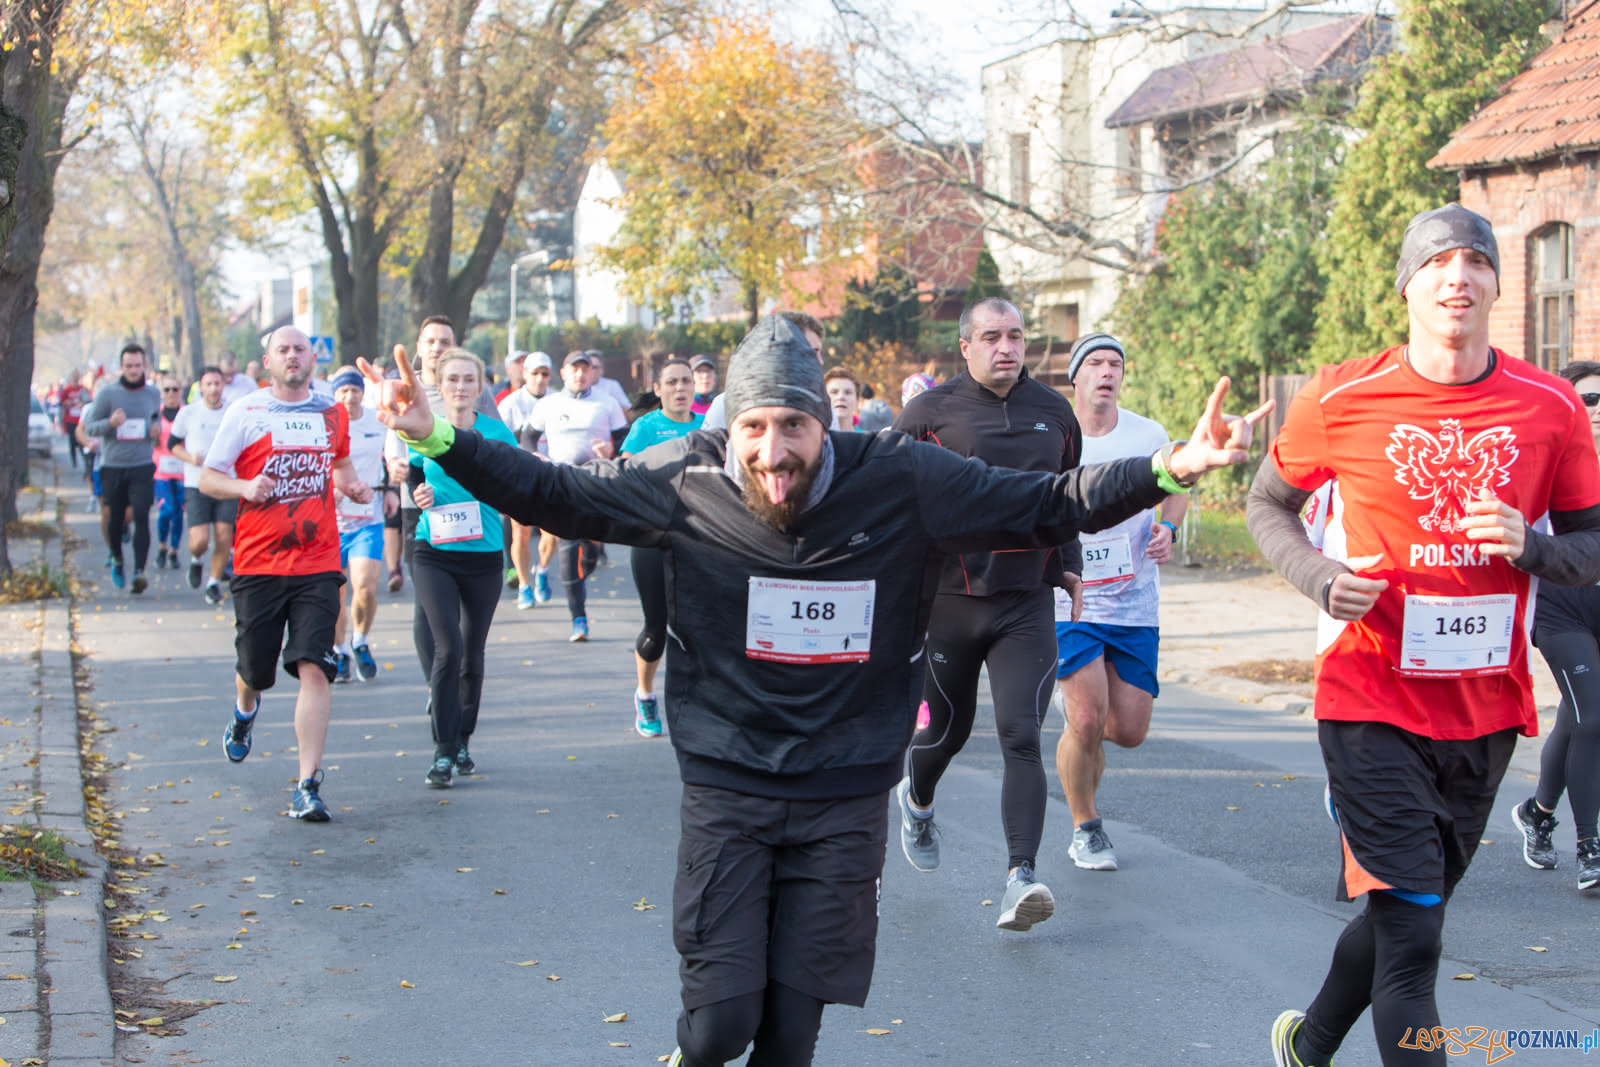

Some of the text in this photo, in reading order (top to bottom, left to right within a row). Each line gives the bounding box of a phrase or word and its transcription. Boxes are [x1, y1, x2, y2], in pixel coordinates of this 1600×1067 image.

[284, 421, 312, 431] 1426
[441, 511, 467, 523] 1395
[1086, 548, 1110, 562] 517
[1409, 544, 1490, 567] POLSKA
[791, 601, 836, 620] 168
[1435, 615, 1487, 636] 1463
